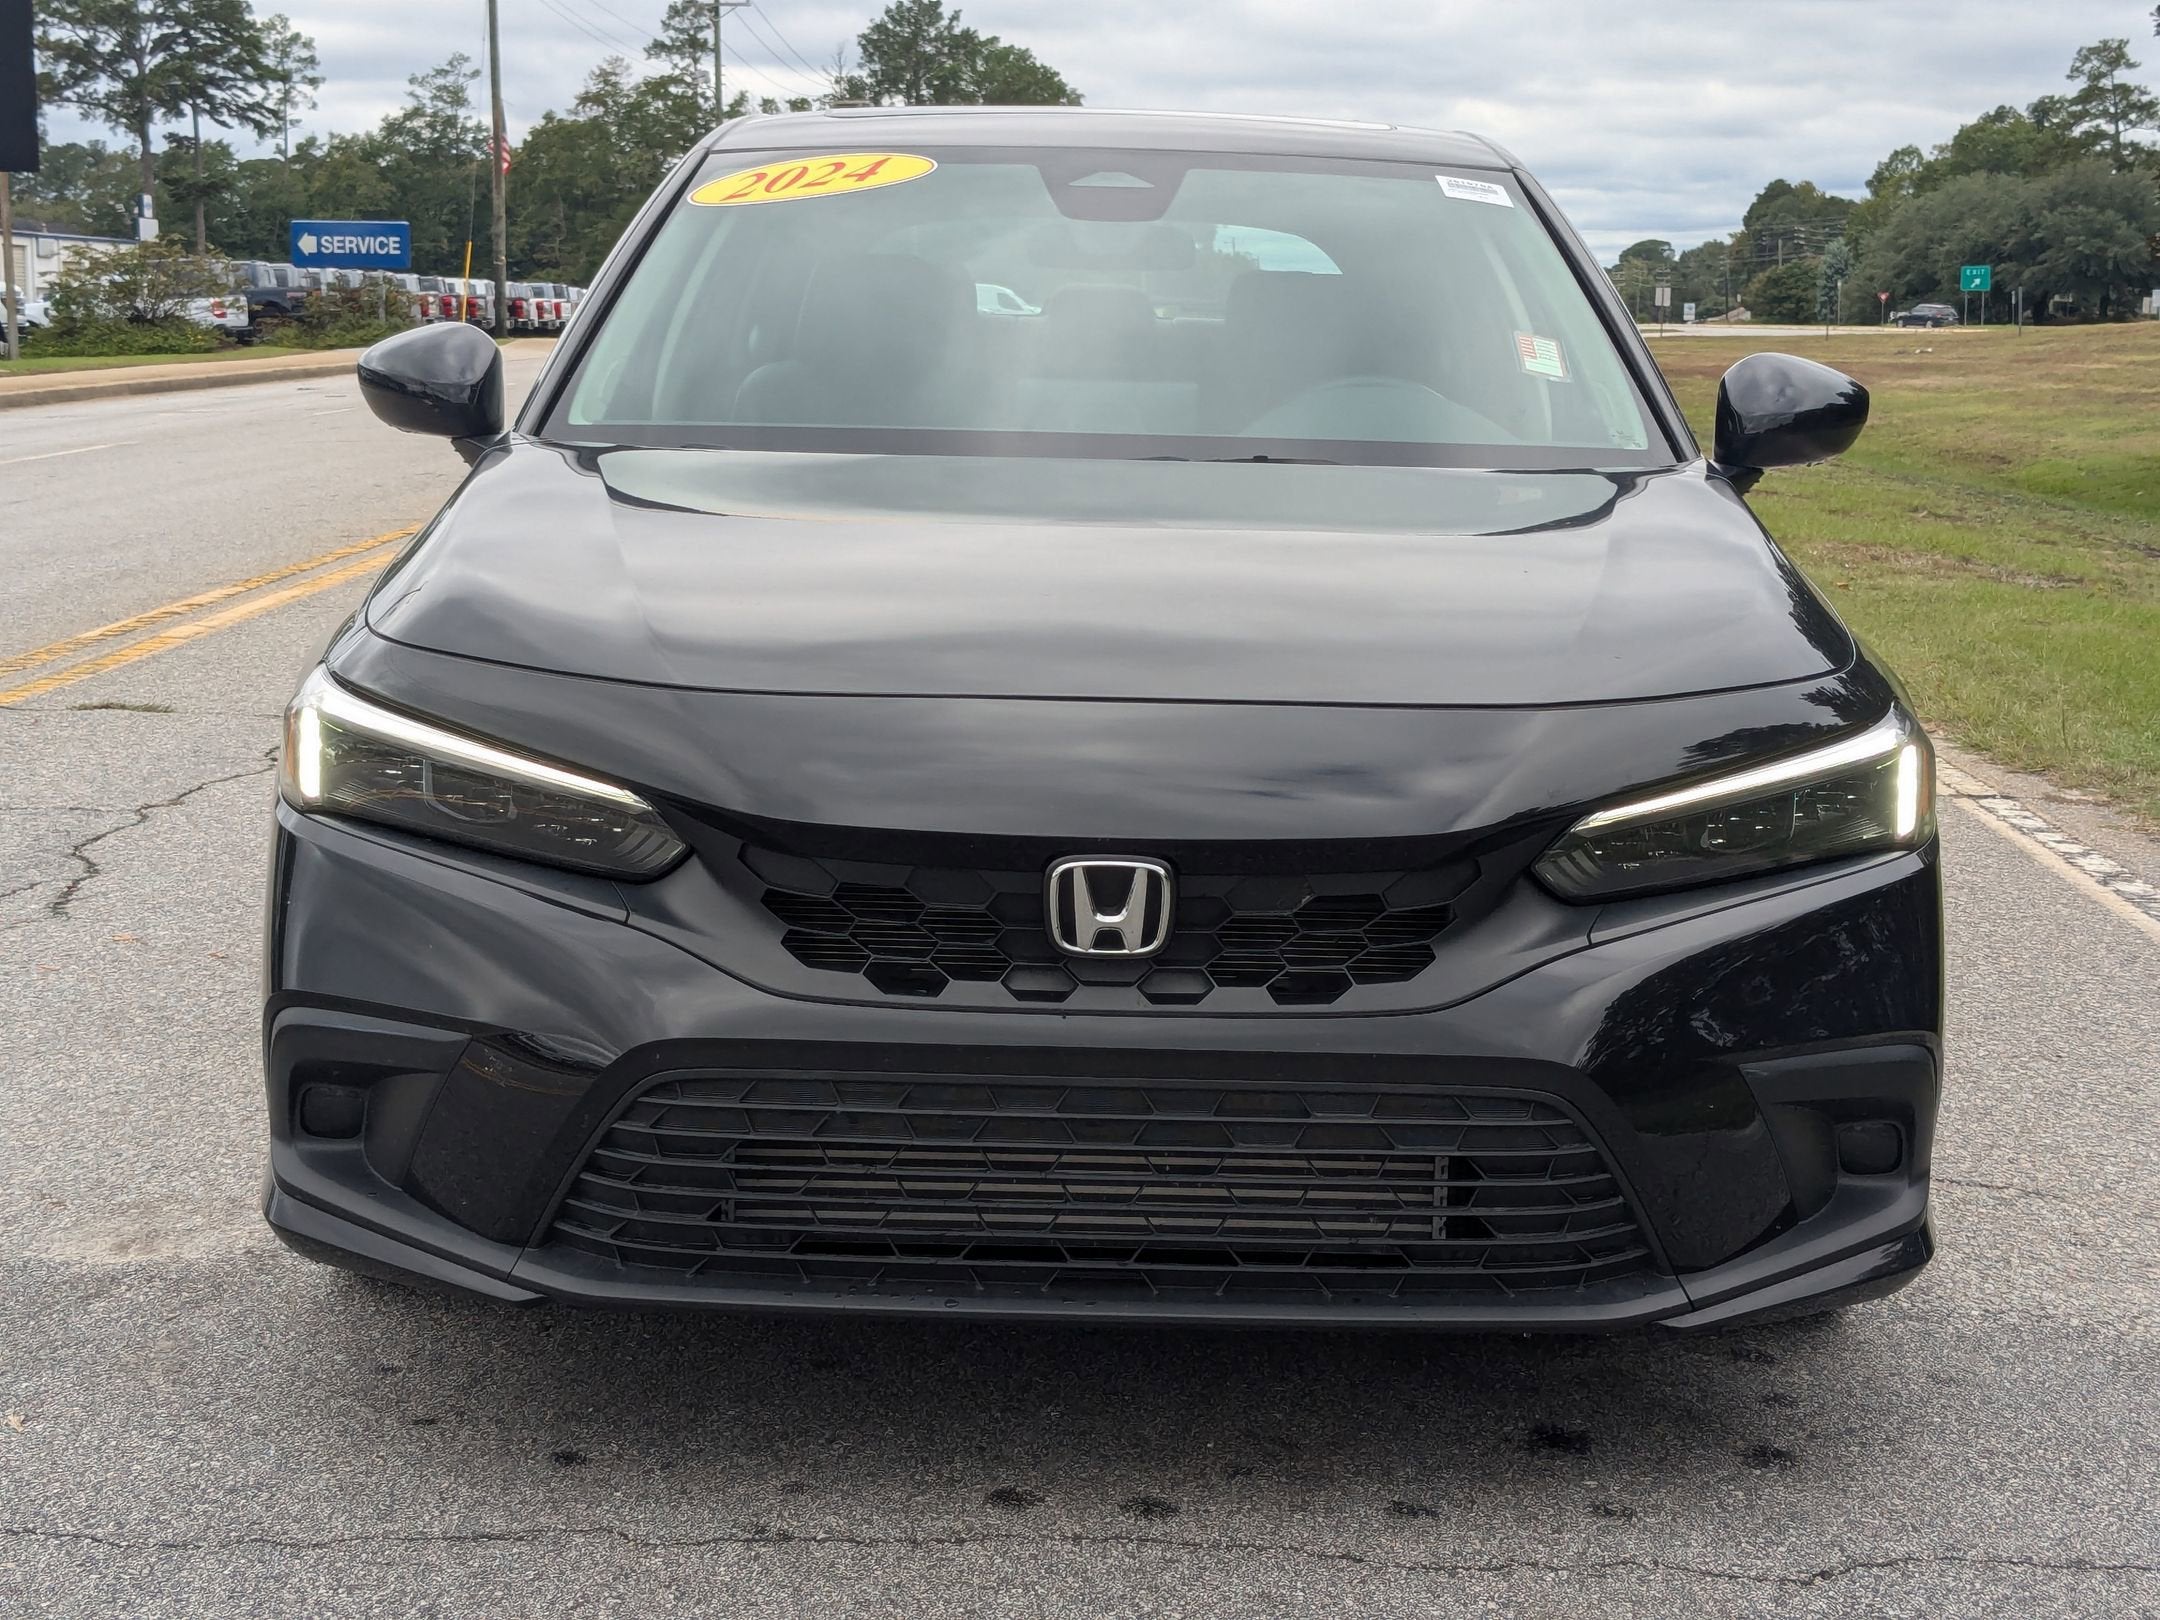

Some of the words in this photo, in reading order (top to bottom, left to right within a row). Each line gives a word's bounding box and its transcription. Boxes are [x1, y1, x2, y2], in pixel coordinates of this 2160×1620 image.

[719, 156, 893, 202] 2024
[320, 235, 401, 255] SERVICE
[1966, 268, 1985, 276] EXIT
